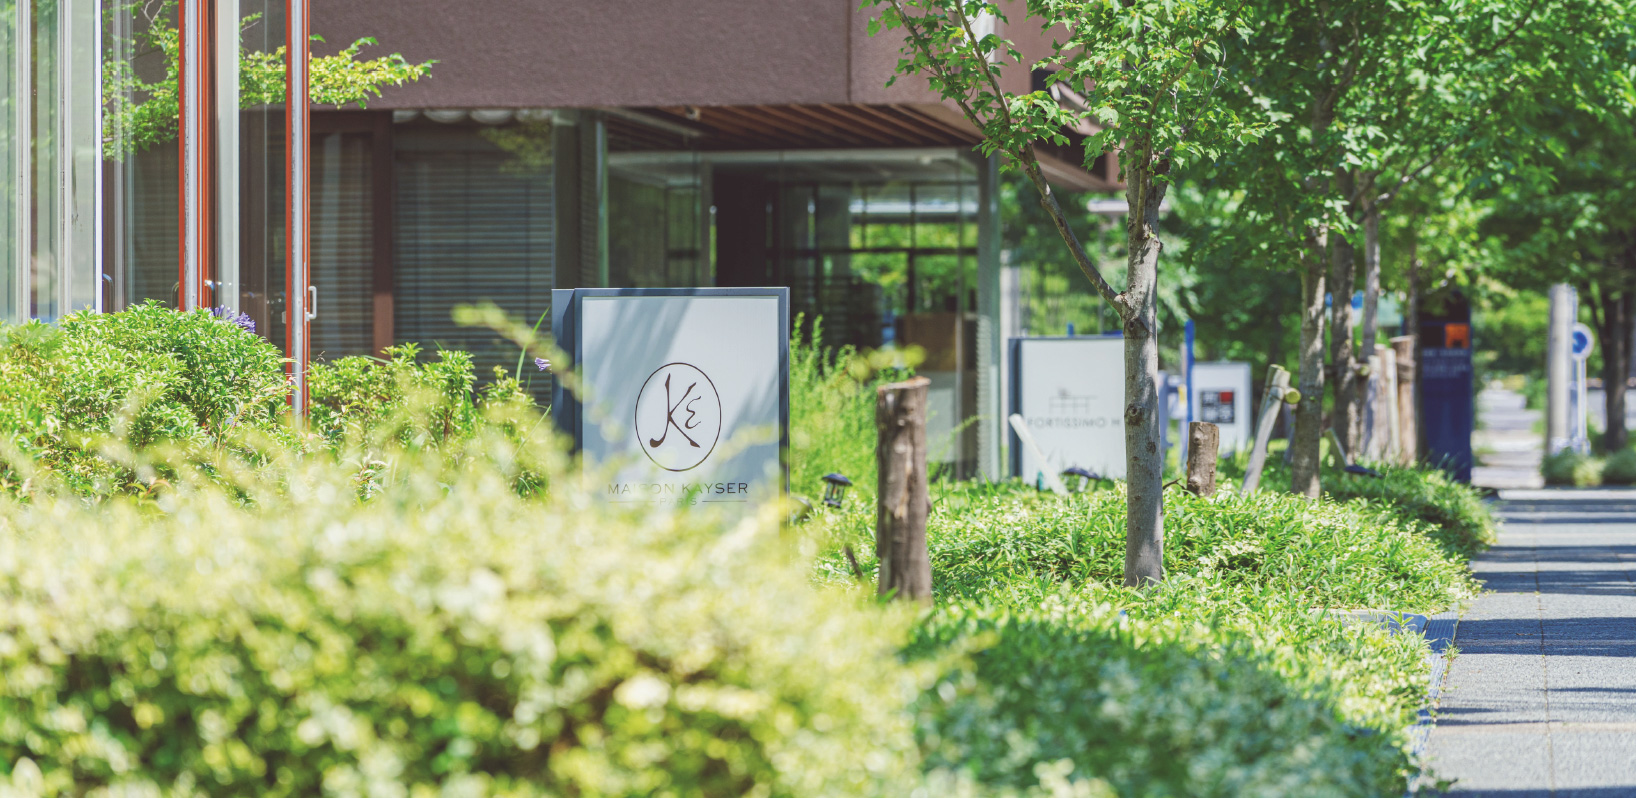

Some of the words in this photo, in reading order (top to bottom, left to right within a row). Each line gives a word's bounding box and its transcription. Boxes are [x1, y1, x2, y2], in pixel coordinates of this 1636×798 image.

[1027, 417, 1107, 428] FORTISSIMO
[681, 482, 748, 494] KAYSER
[659, 497, 698, 506] PARS
